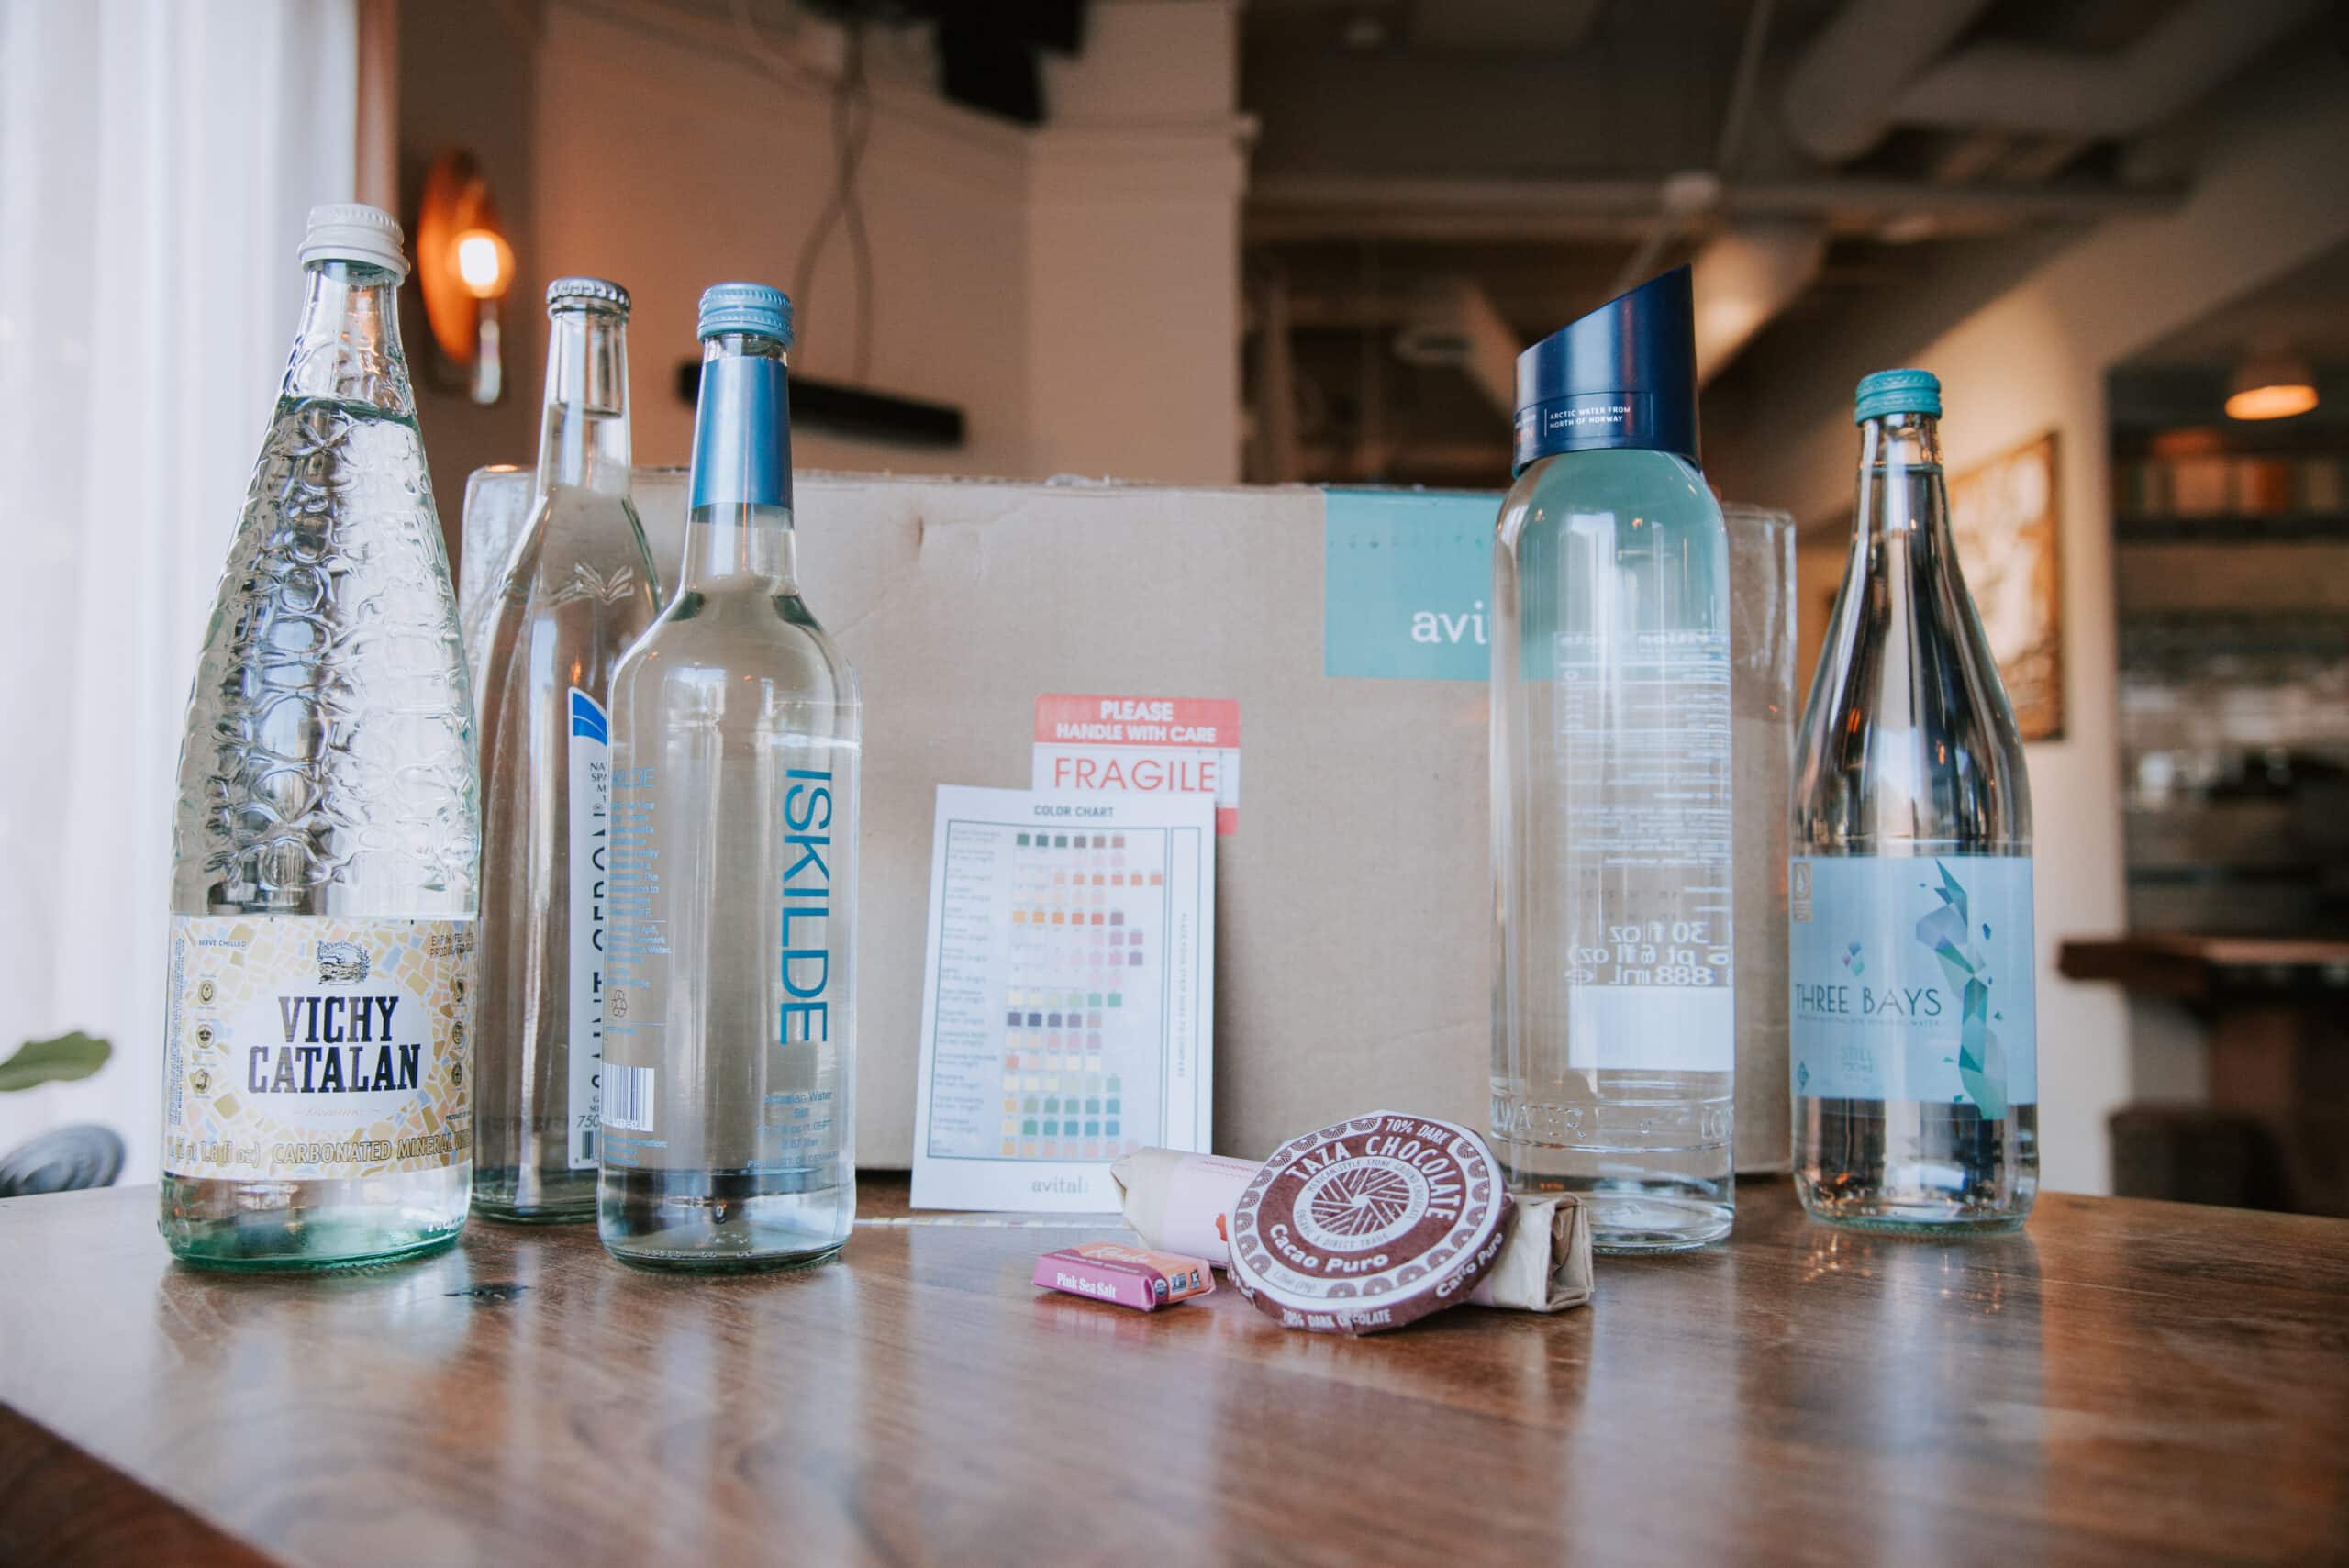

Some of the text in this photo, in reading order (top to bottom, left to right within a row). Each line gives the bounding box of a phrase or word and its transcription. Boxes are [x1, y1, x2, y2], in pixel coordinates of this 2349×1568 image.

[1549, 406, 1631, 419] ARCTIC WATER FROM
[1549, 419, 1575, 428] NORTH
[1588, 416, 1623, 424] NORWAY
[1100, 699, 1174, 722] PLEASE
[1055, 722, 1216, 743] HANDLE WITH CARE
[1054, 757, 1216, 793] FRAGILE
[1034, 805, 1114, 817] COLOR CHART
[781, 769, 832, 1046] ISKILDE
[198, 939, 247, 948] SERVE CHILLED
[1795, 983, 1943, 1017] THREE BAYS
[278, 995, 400, 1043] VICHY
[248, 1044, 421, 1093] CATALAN
[809, 1090, 834, 1102] Water
[1386, 1118, 1452, 1145] 70% DARK
[272, 1140, 393, 1163] CARBONATED
[396, 1133, 453, 1160] MINERAL
[1285, 1135, 1462, 1223] TAZA CHOCOLATE
[1307, 1165, 1337, 1192] MEXICAN
[1339, 1159, 1361, 1172] STYLE
[1270, 1224, 1389, 1273] Cacao Puro
[1361, 1233, 1389, 1247] TRADE
[1056, 1272, 1117, 1299] Pink Sea Salt
